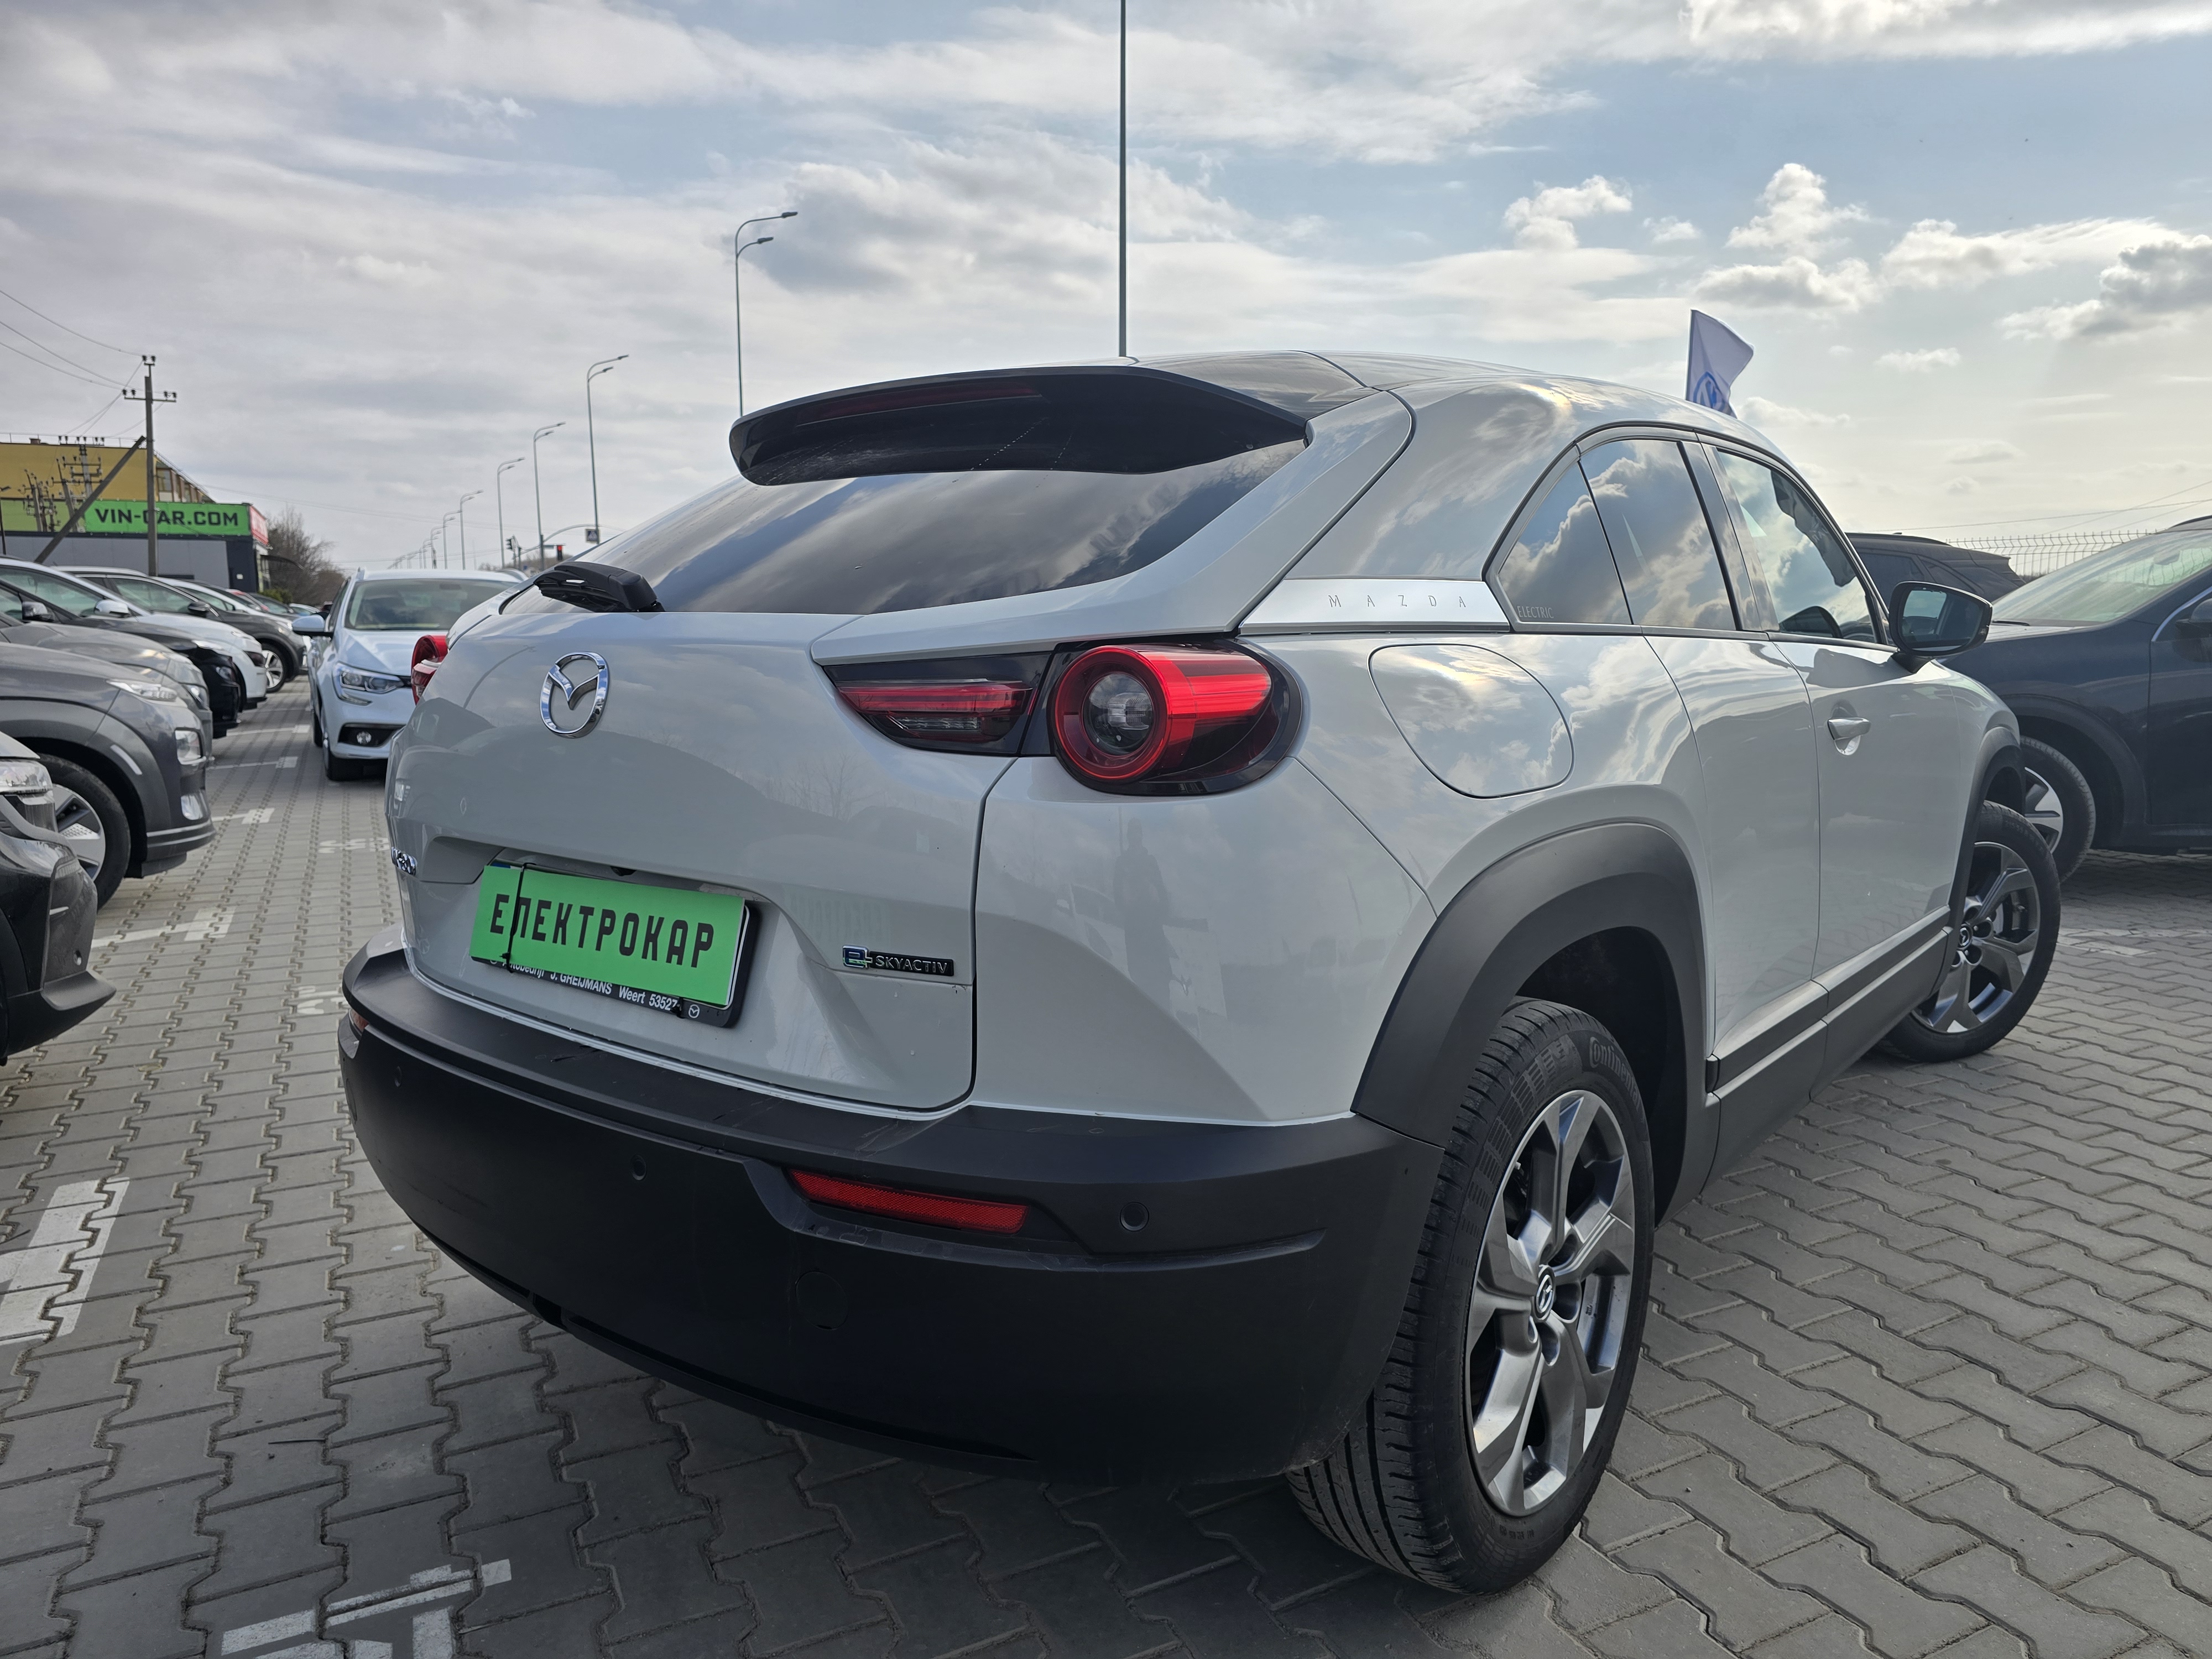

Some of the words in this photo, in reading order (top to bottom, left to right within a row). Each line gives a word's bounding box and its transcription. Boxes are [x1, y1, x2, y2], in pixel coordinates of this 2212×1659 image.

[1328, 595, 1466, 608] MAZDA
[1516, 606, 1554, 619] ELECTRIC
[490, 893, 714, 968] ЕЛЕКТРОКАР
[875, 955, 947, 974] SKYACTIV
[502, 962, 545, 979] tobedrijf
[619, 985, 646, 1005] Weert
[1589, 1036, 1642, 1113] Continental
